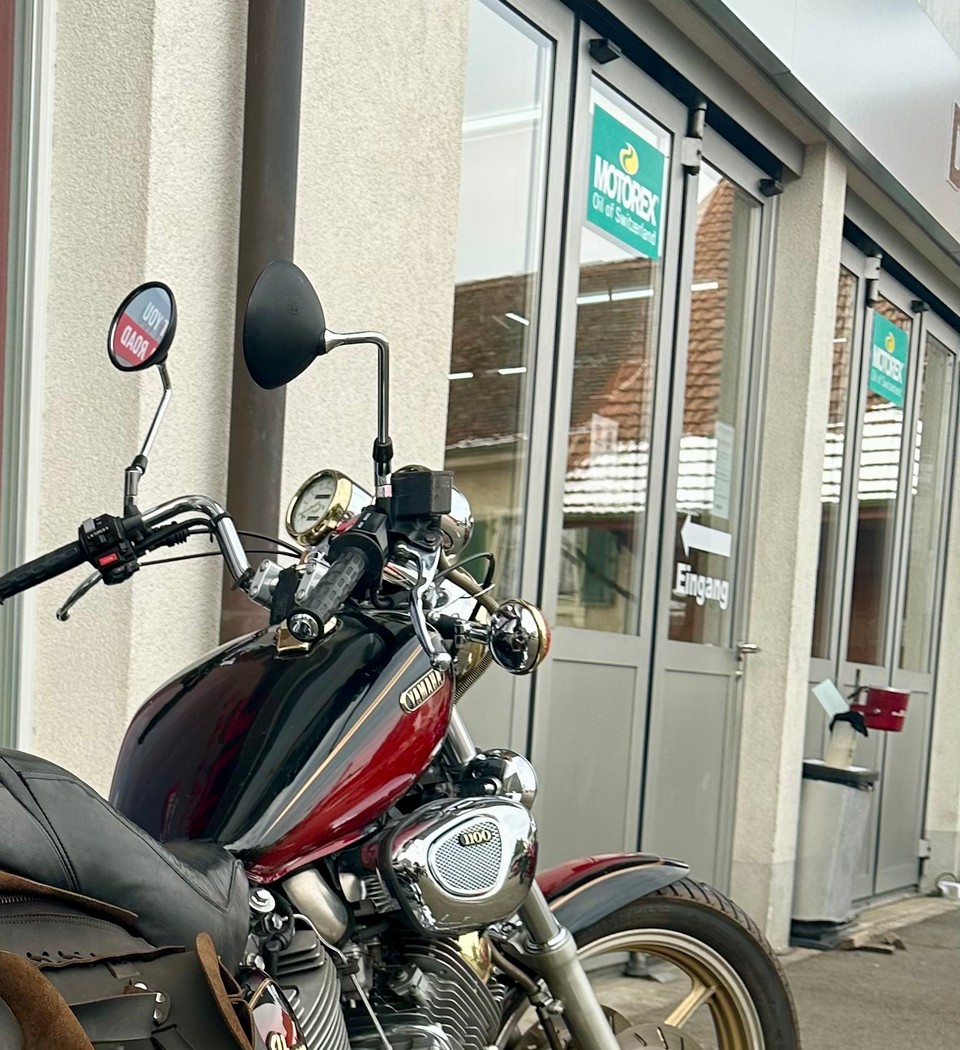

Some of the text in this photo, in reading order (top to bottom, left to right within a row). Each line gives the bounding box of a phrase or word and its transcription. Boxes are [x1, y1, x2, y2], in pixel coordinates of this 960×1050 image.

[593, 154, 659, 227] MOTOREX
[592, 191, 657, 246] Oil of Switzerland
[675, 562, 729, 610] Eingang
[406, 669, 443, 708] YAMAHA
[463, 829, 492, 845] 1100
